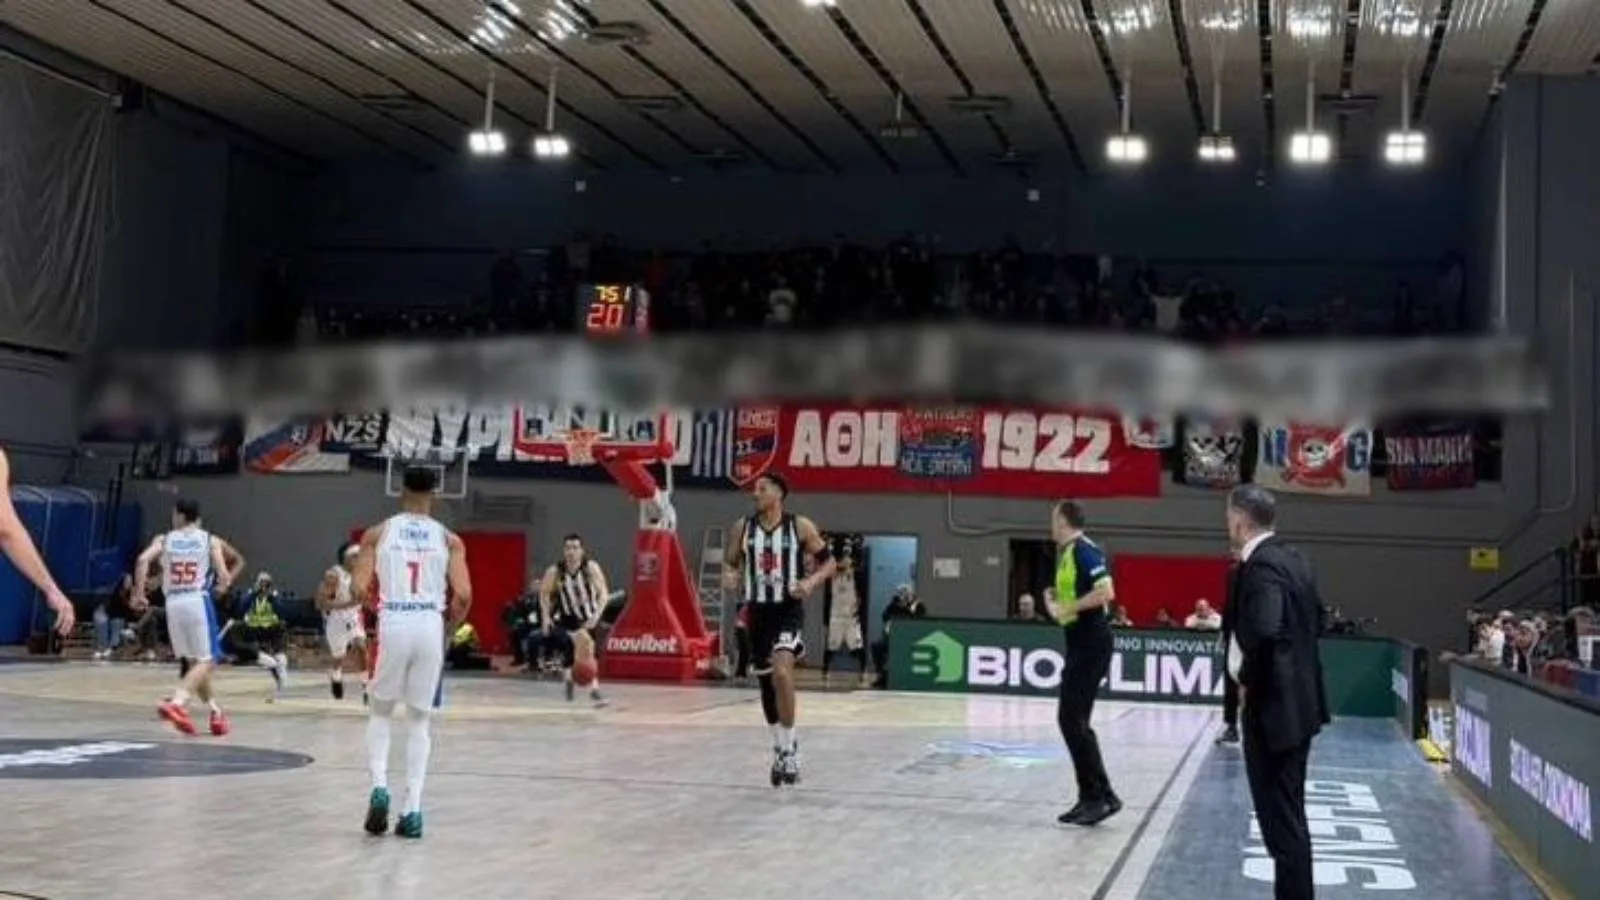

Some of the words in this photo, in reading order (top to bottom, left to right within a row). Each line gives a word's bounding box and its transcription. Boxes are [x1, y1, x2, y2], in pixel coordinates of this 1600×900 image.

[587, 304, 624, 328] 20
[982, 412, 1112, 473] 1922
[170, 561, 198, 585] 55
[406, 561, 421, 594] 7
[606, 633, 678, 654] novibet
